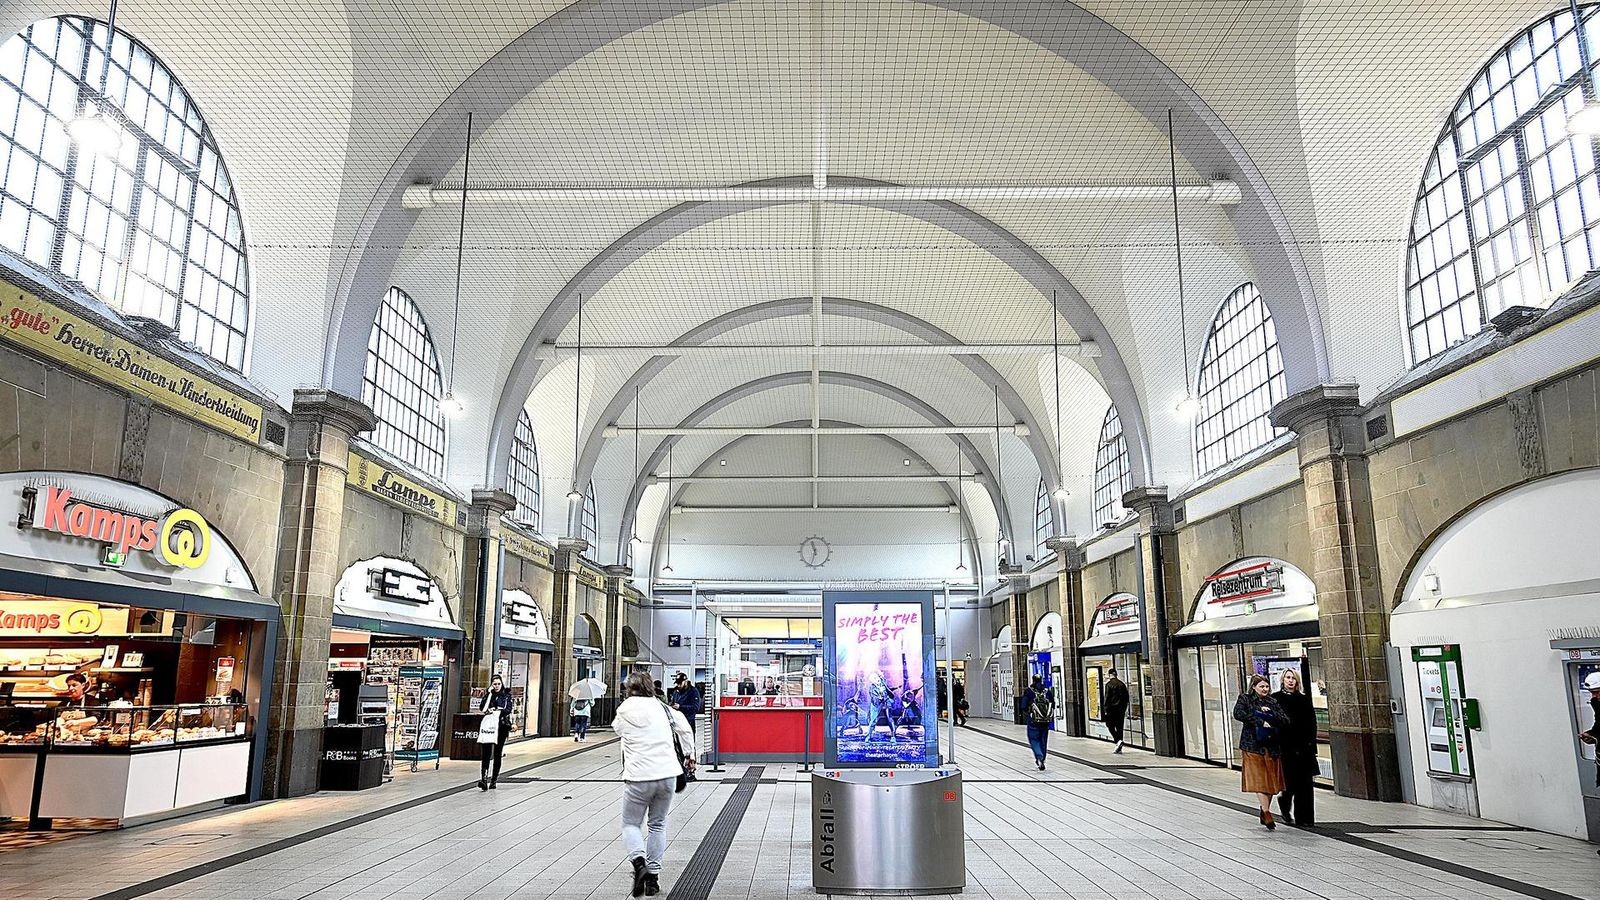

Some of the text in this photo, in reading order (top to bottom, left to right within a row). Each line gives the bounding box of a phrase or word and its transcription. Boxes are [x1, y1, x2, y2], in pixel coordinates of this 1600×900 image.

[177, 377, 259, 434] Kinderkleidung
[378, 471, 436, 509] Lampe
[44, 486, 158, 555] Kamps
[1211, 575, 1263, 597] Reisezentrum
[837, 612, 918, 628] SIMPLY THE
[857, 627, 904, 643] BEST
[1570, 650, 1580, 659] DB
[945, 792, 956, 800] DB
[820, 809, 834, 873] Abfall
